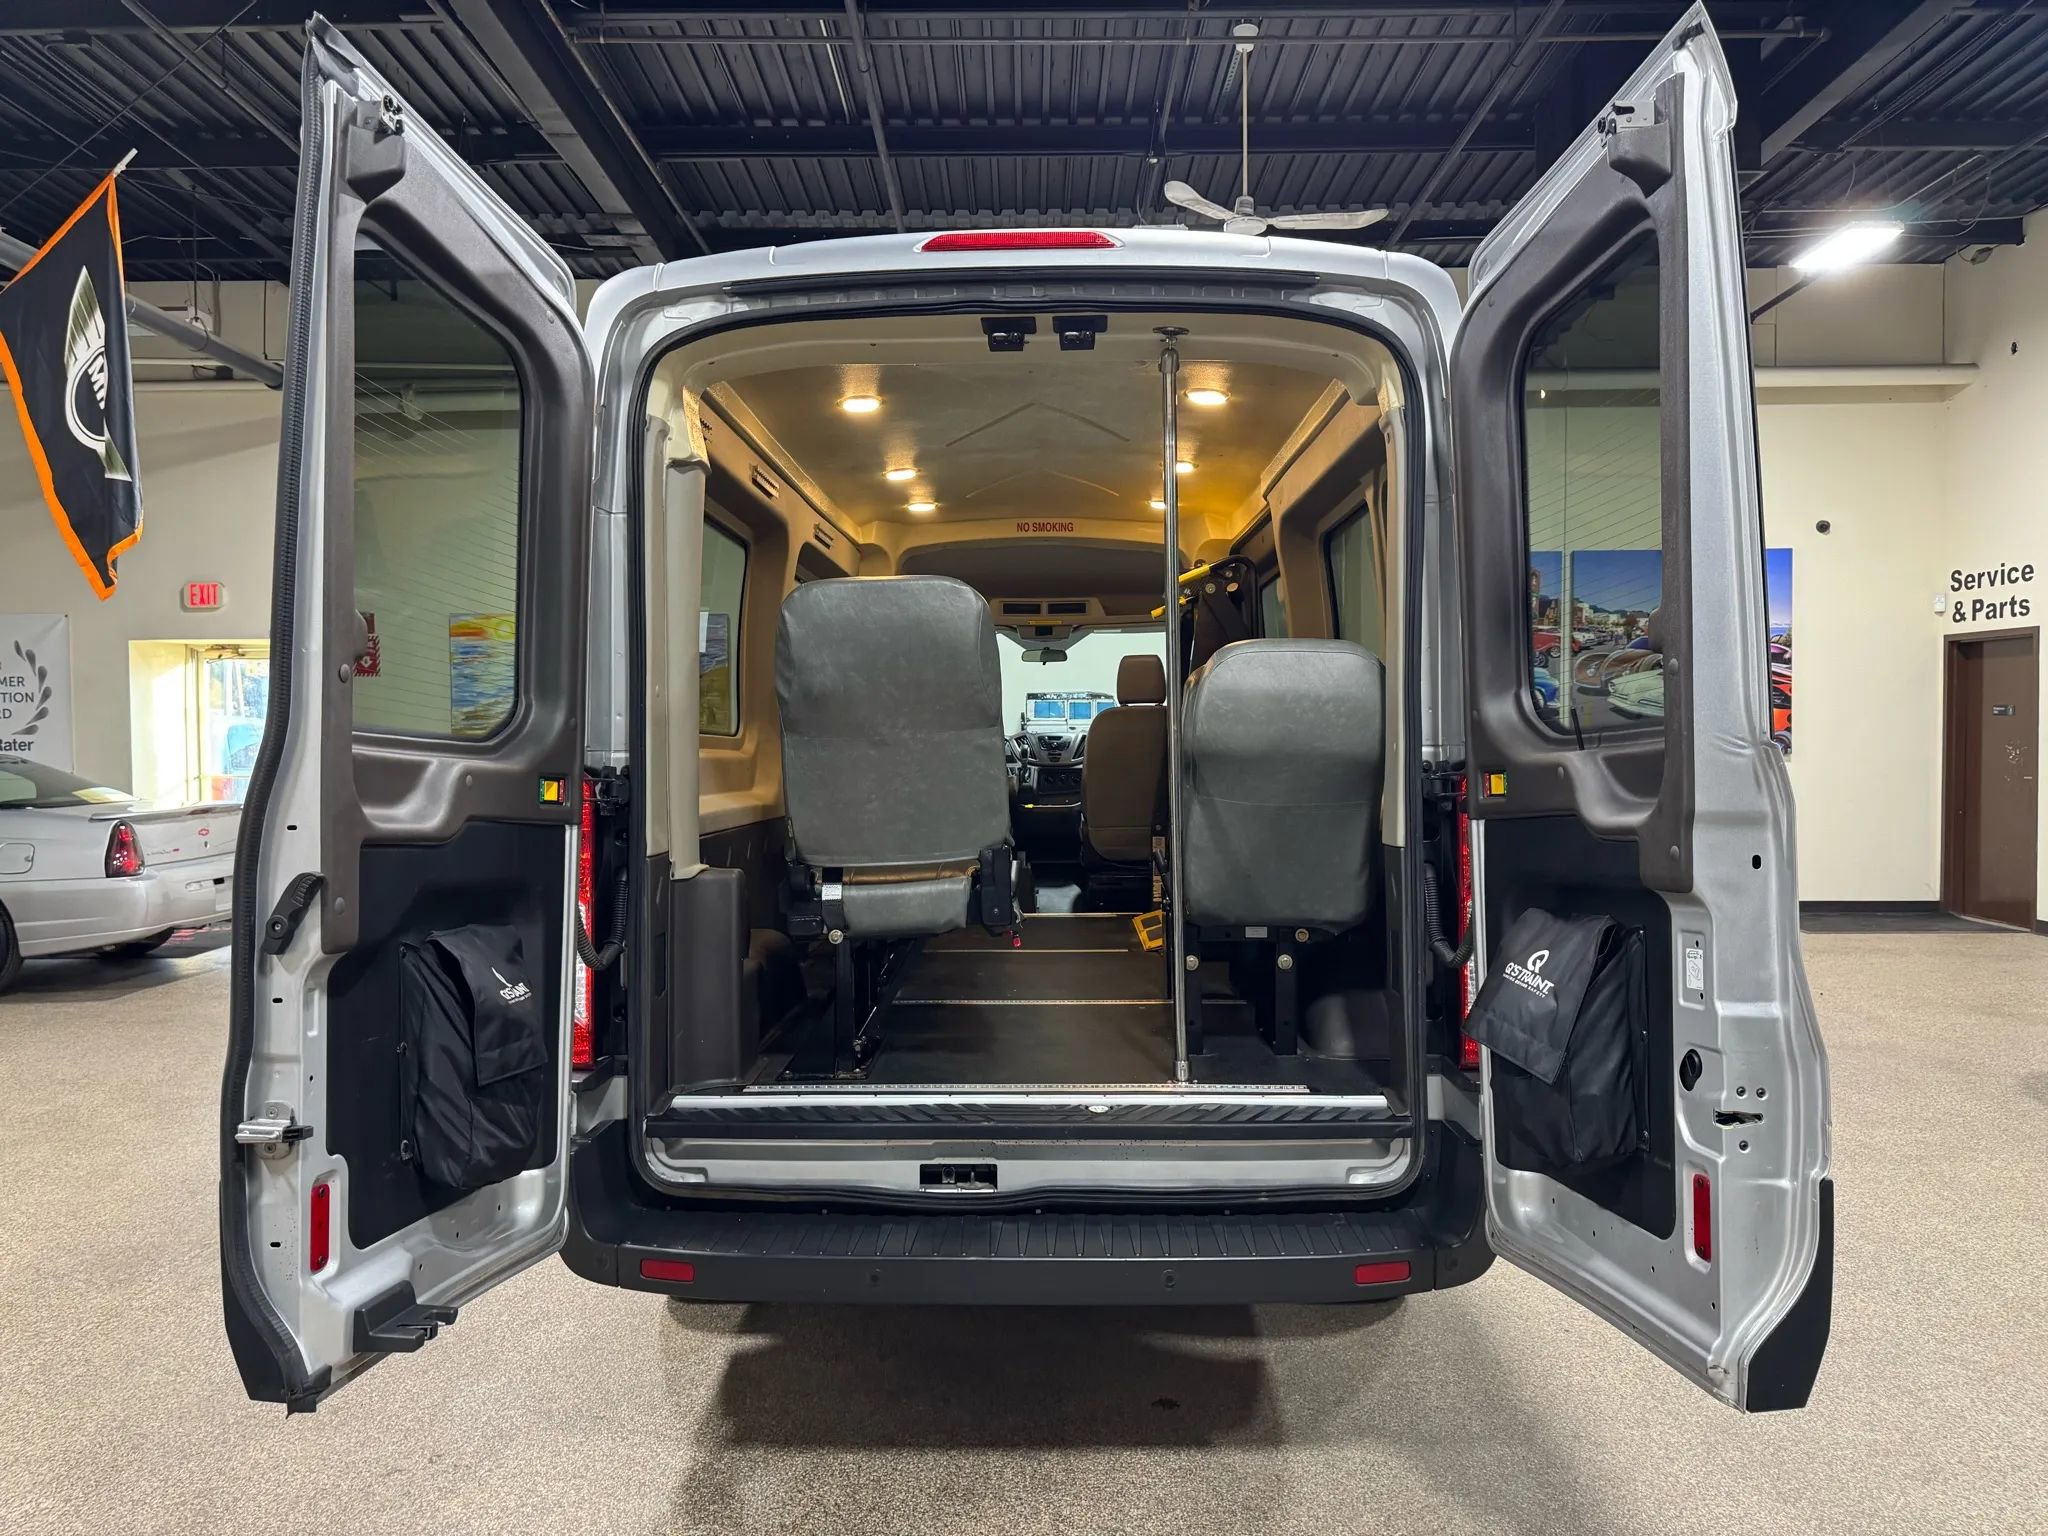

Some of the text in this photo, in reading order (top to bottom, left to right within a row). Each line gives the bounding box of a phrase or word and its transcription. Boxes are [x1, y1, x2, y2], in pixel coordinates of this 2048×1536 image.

[1017, 522, 1074, 533] NO SMOKING
[1950, 562, 2035, 592] Service
[190, 583, 219, 606] EXIT
[1952, 594, 2030, 623] & Parts
[0, 708, 12, 719] D
